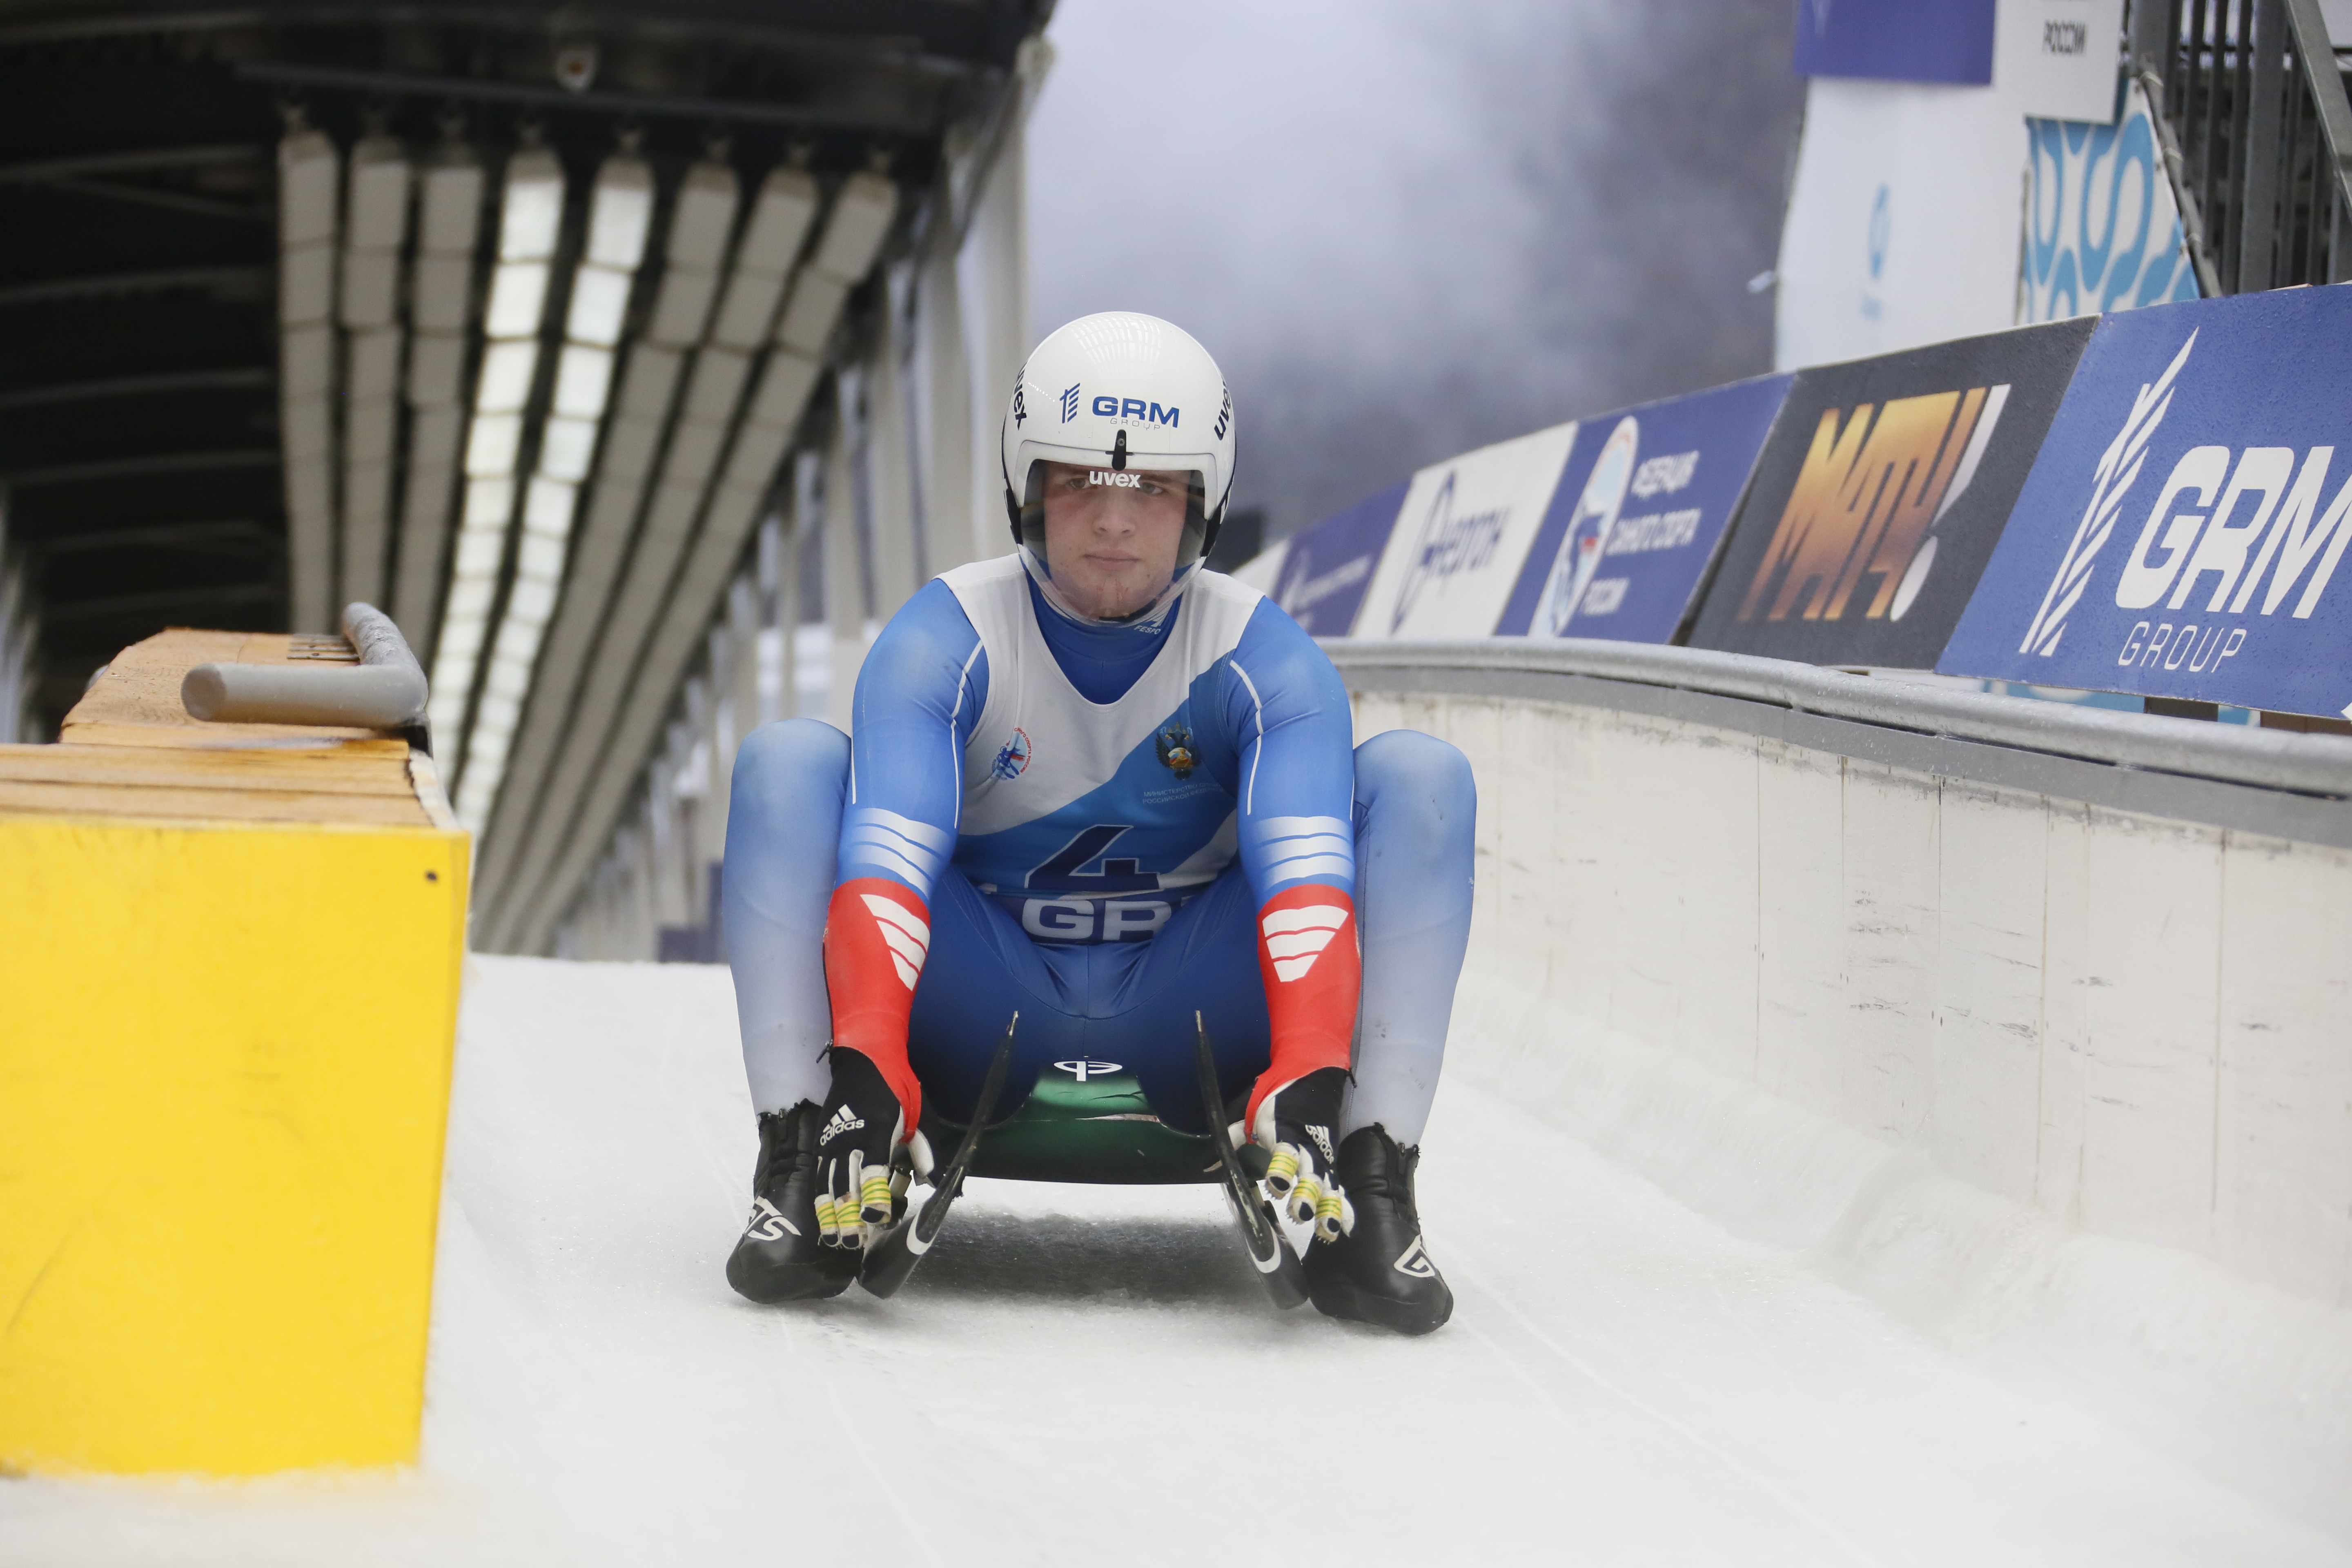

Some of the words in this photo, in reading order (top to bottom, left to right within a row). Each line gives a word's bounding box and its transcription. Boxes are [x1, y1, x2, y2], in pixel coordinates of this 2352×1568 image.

[1092, 396, 1179, 428] GRM
[1214, 375, 1230, 441] uve
[1089, 470, 1141, 488] uvex
[2116, 445, 2352, 619] GRM
[2118, 621, 2247, 673] GROUP
[1020, 755, 1031, 773] РОССИИ
[1143, 784, 1197, 797] МИНИСТЕРСТВО
[1024, 824, 1161, 892] 4
[820, 1119, 865, 1146] adidas
